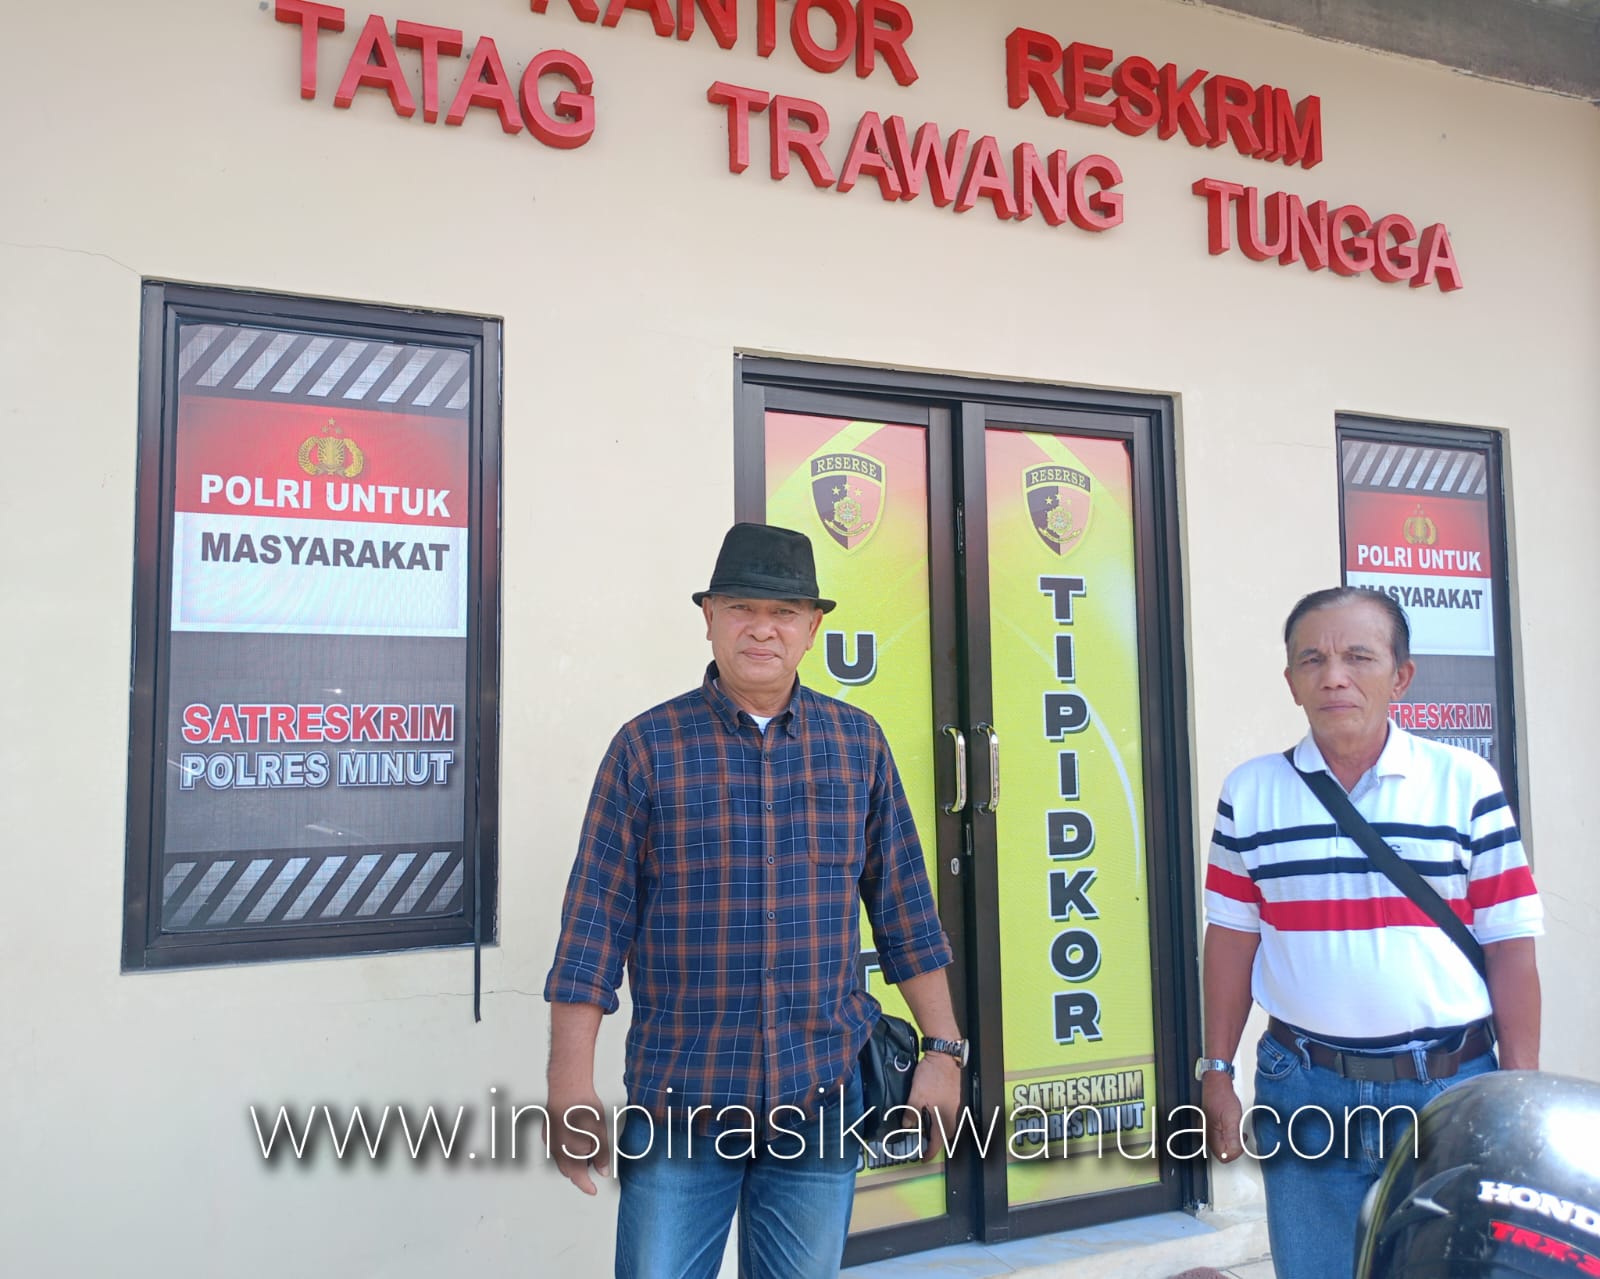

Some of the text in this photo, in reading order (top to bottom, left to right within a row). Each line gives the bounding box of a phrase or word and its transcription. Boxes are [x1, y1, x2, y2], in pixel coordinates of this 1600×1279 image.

[530, 0, 1322, 169] NTOR RESKRIM
[275, 0, 1463, 292] TATAG TRAWANG TUNGGA
[816, 456, 877, 478] RESERSE
[1030, 471, 1086, 488] RESERSE
[201, 474, 451, 517] POLRI UNTUK
[201, 532, 450, 571] MASYARAKAT
[1357, 544, 1482, 572] POLRI UNTUK
[1360, 584, 1483, 609] SYARAKAT
[182, 704, 454, 743] SATRESKRIM
[1388, 703, 1492, 729] TRESKRIM
[180, 750, 454, 790] POLRES MINUT
[1039, 576, 1102, 1043] TIPIDKOR
[1013, 1070, 1144, 1115] SATRESKRIM
[1477, 1180, 1600, 1237] HOND
